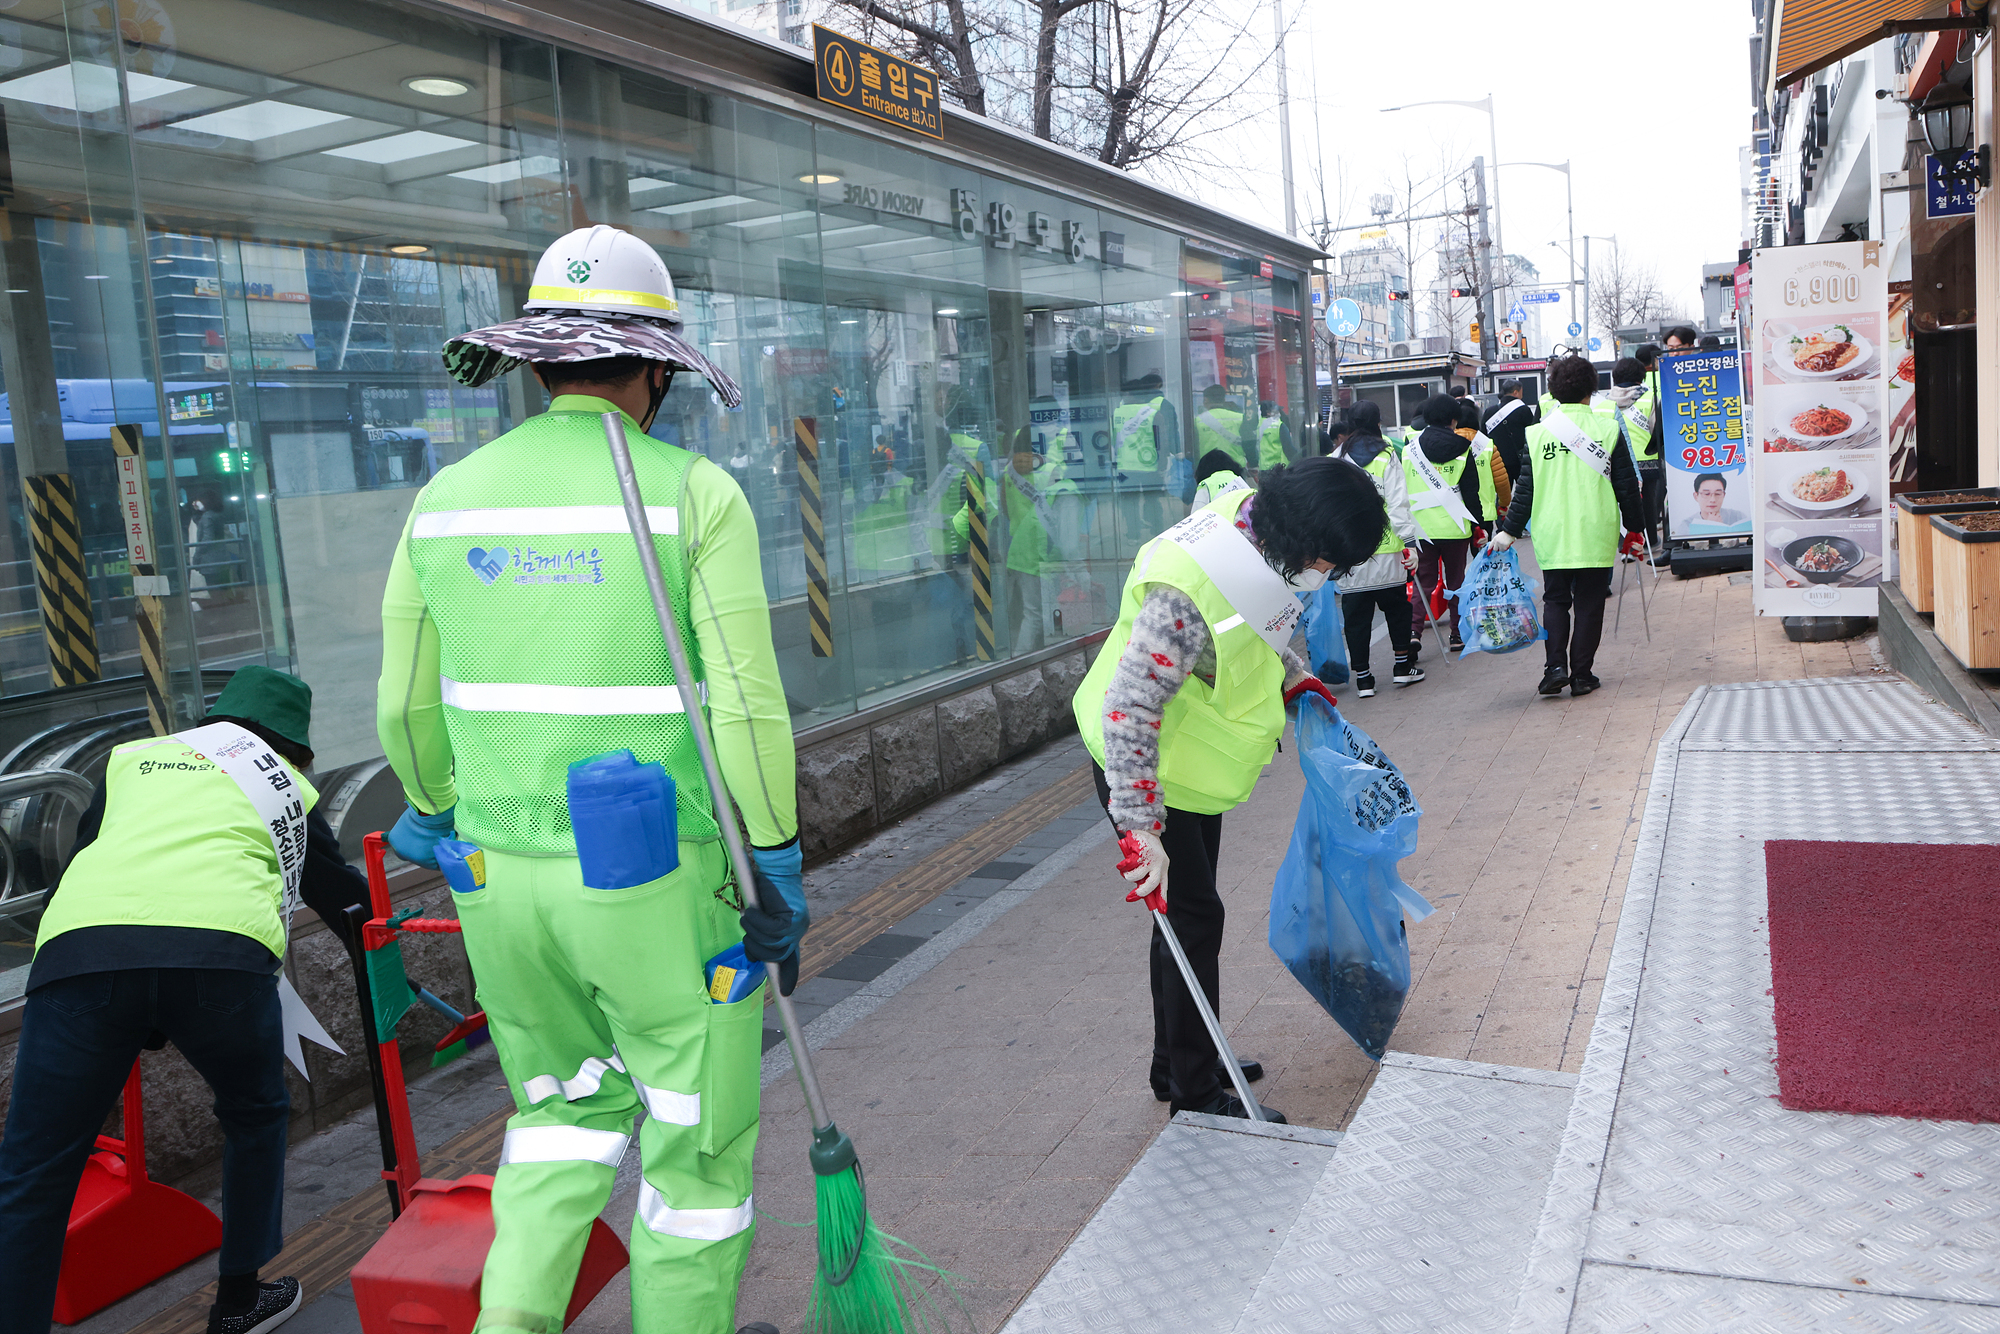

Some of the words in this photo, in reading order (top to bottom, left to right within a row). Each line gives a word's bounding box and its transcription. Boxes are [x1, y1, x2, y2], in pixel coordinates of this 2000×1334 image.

[859, 52, 934, 108] 출입구
[861, 88, 910, 121] Entrance
[911, 107, 937, 130] 出入口
[1784, 273, 1860, 307] 6,900
[1676, 375, 1718, 398] 누진
[1677, 395, 1742, 419] 다초점
[369, 429, 384, 440] 150
[1679, 418, 1743, 444] 성공률
[1681, 443, 1746, 469] 98.7%
[123, 457, 147, 562] 미끄럼주의
[513, 575, 535, 585] 시민과
[553, 574, 575, 584] 세계와
[139, 760, 215, 775] 함께해요!
[270, 815, 295, 872] 청소는
